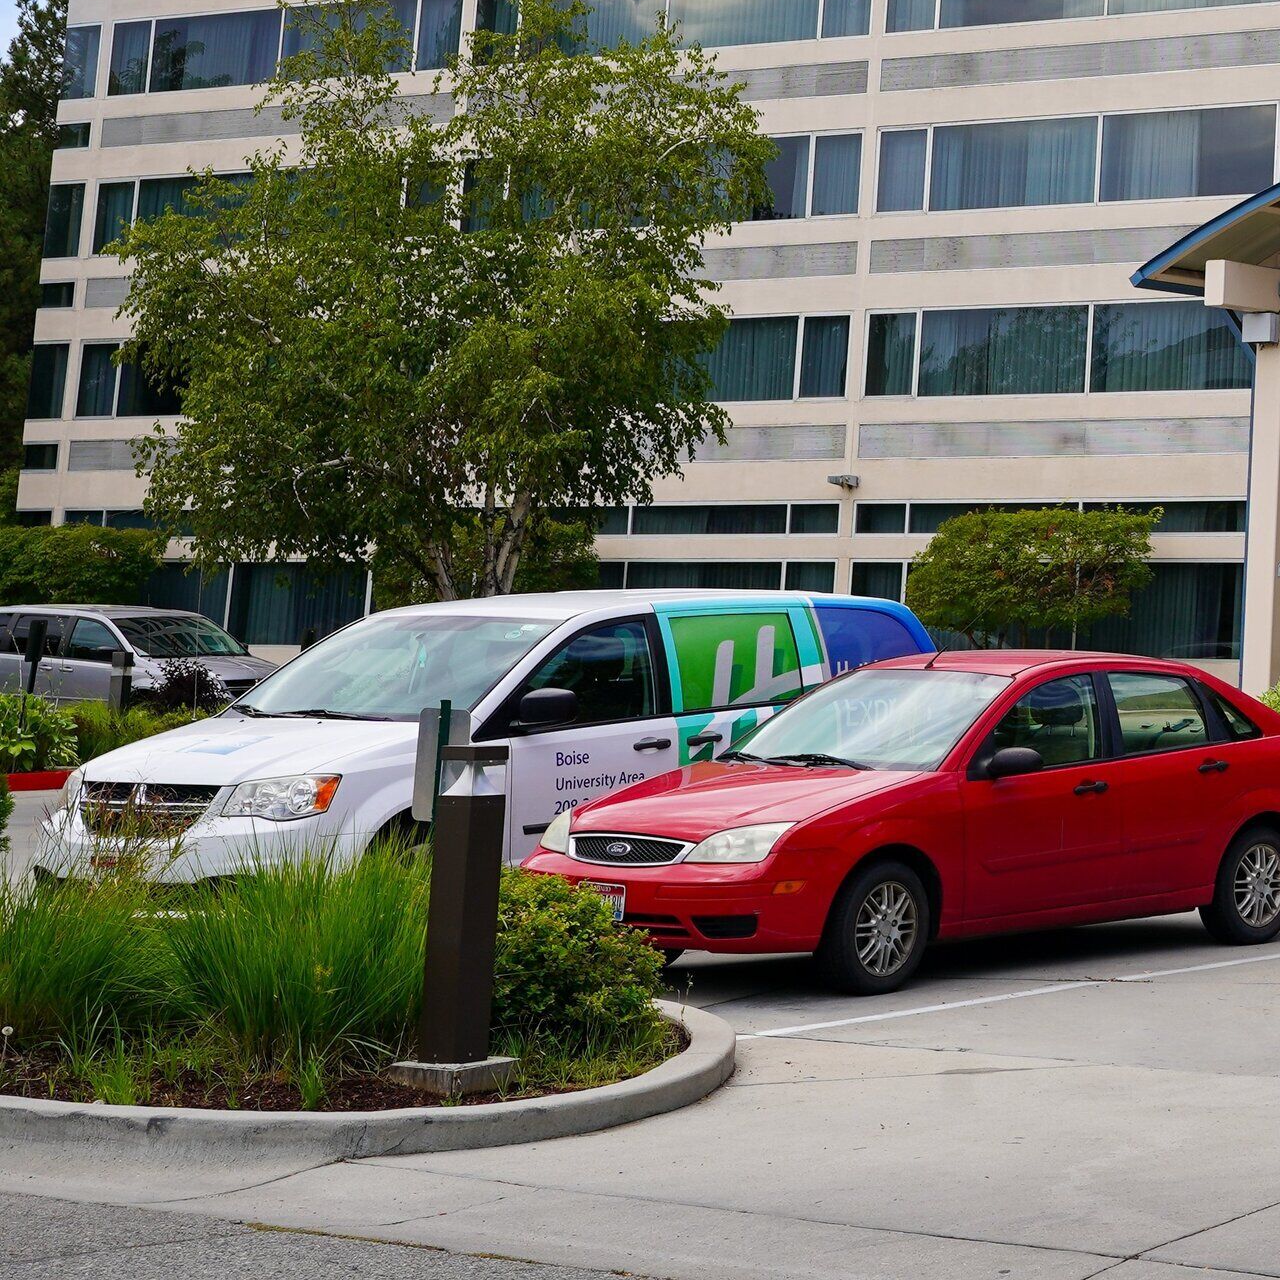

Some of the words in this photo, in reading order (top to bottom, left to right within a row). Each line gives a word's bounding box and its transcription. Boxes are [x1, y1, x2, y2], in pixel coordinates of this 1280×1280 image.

[556, 750, 590, 767] Boise
[555, 773, 617, 791] University
[618, 771, 646, 785] Area
